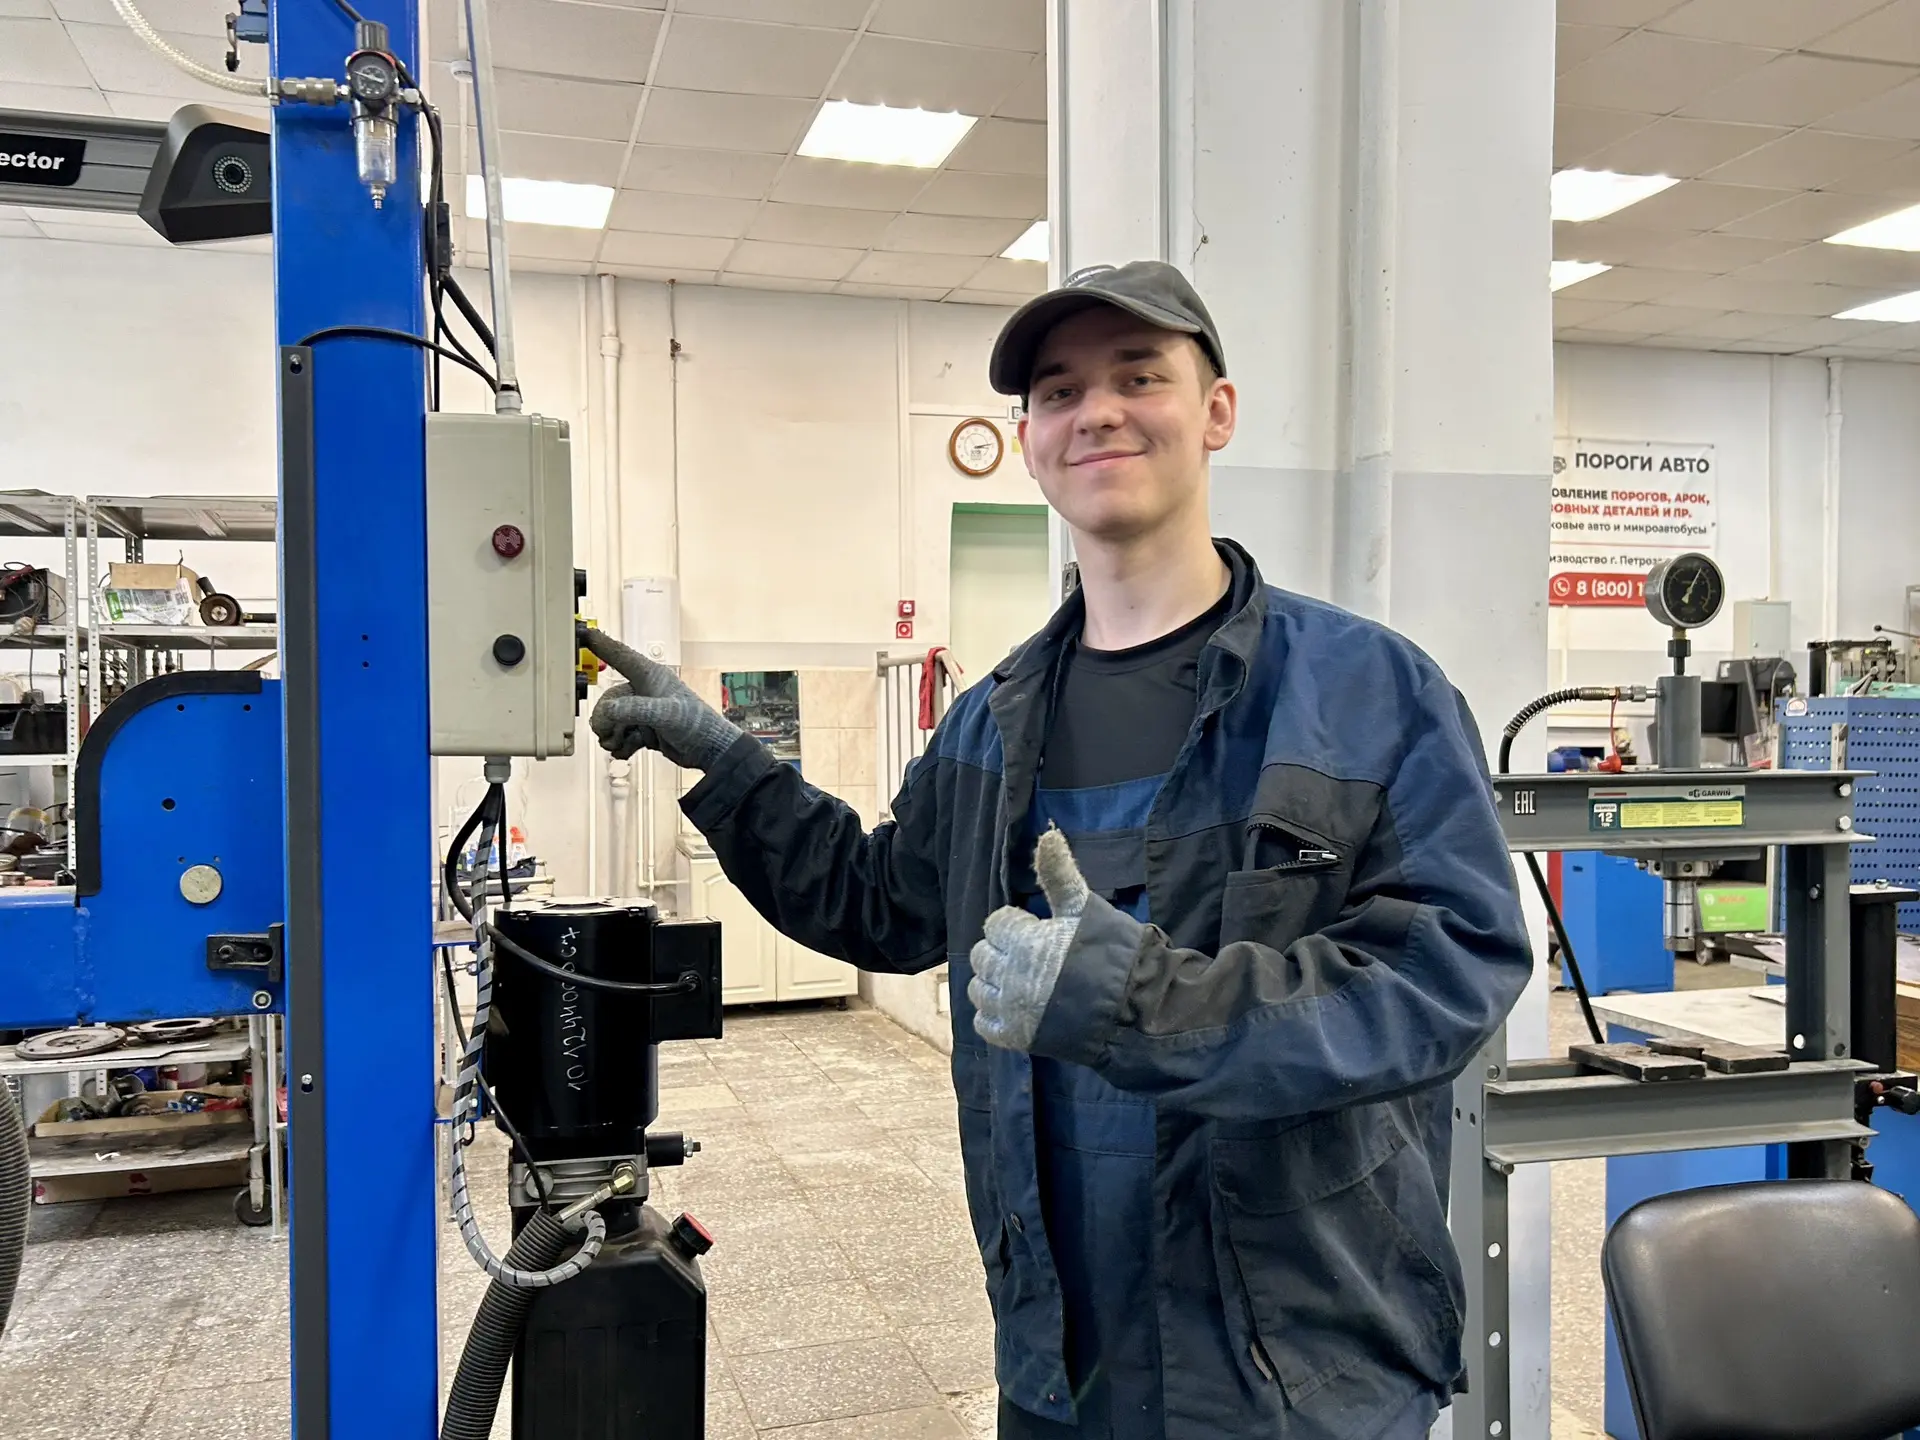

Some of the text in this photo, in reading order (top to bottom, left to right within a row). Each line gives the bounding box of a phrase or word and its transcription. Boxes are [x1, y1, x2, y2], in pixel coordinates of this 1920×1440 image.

[1575, 453, 1710, 473] ПОРОГИ АВТО
[1552, 488, 1710, 505] ОВЛЕНИЕ ПОРОГОВ, АРОК,
[1551, 503, 1692, 518] ОВНЫХ ДЕТАЛЕЙ И ПР.
[1587, 523, 1611, 531] авто
[1623, 523, 1707, 536] микроавтобусы
[1610, 557, 1617, 565] г.
[1576, 580, 1587, 596] 8
[1592, 579, 1633, 598] (800)
[1702, 789, 1731, 797] GARWIN
[1598, 812, 1613, 823] 12
